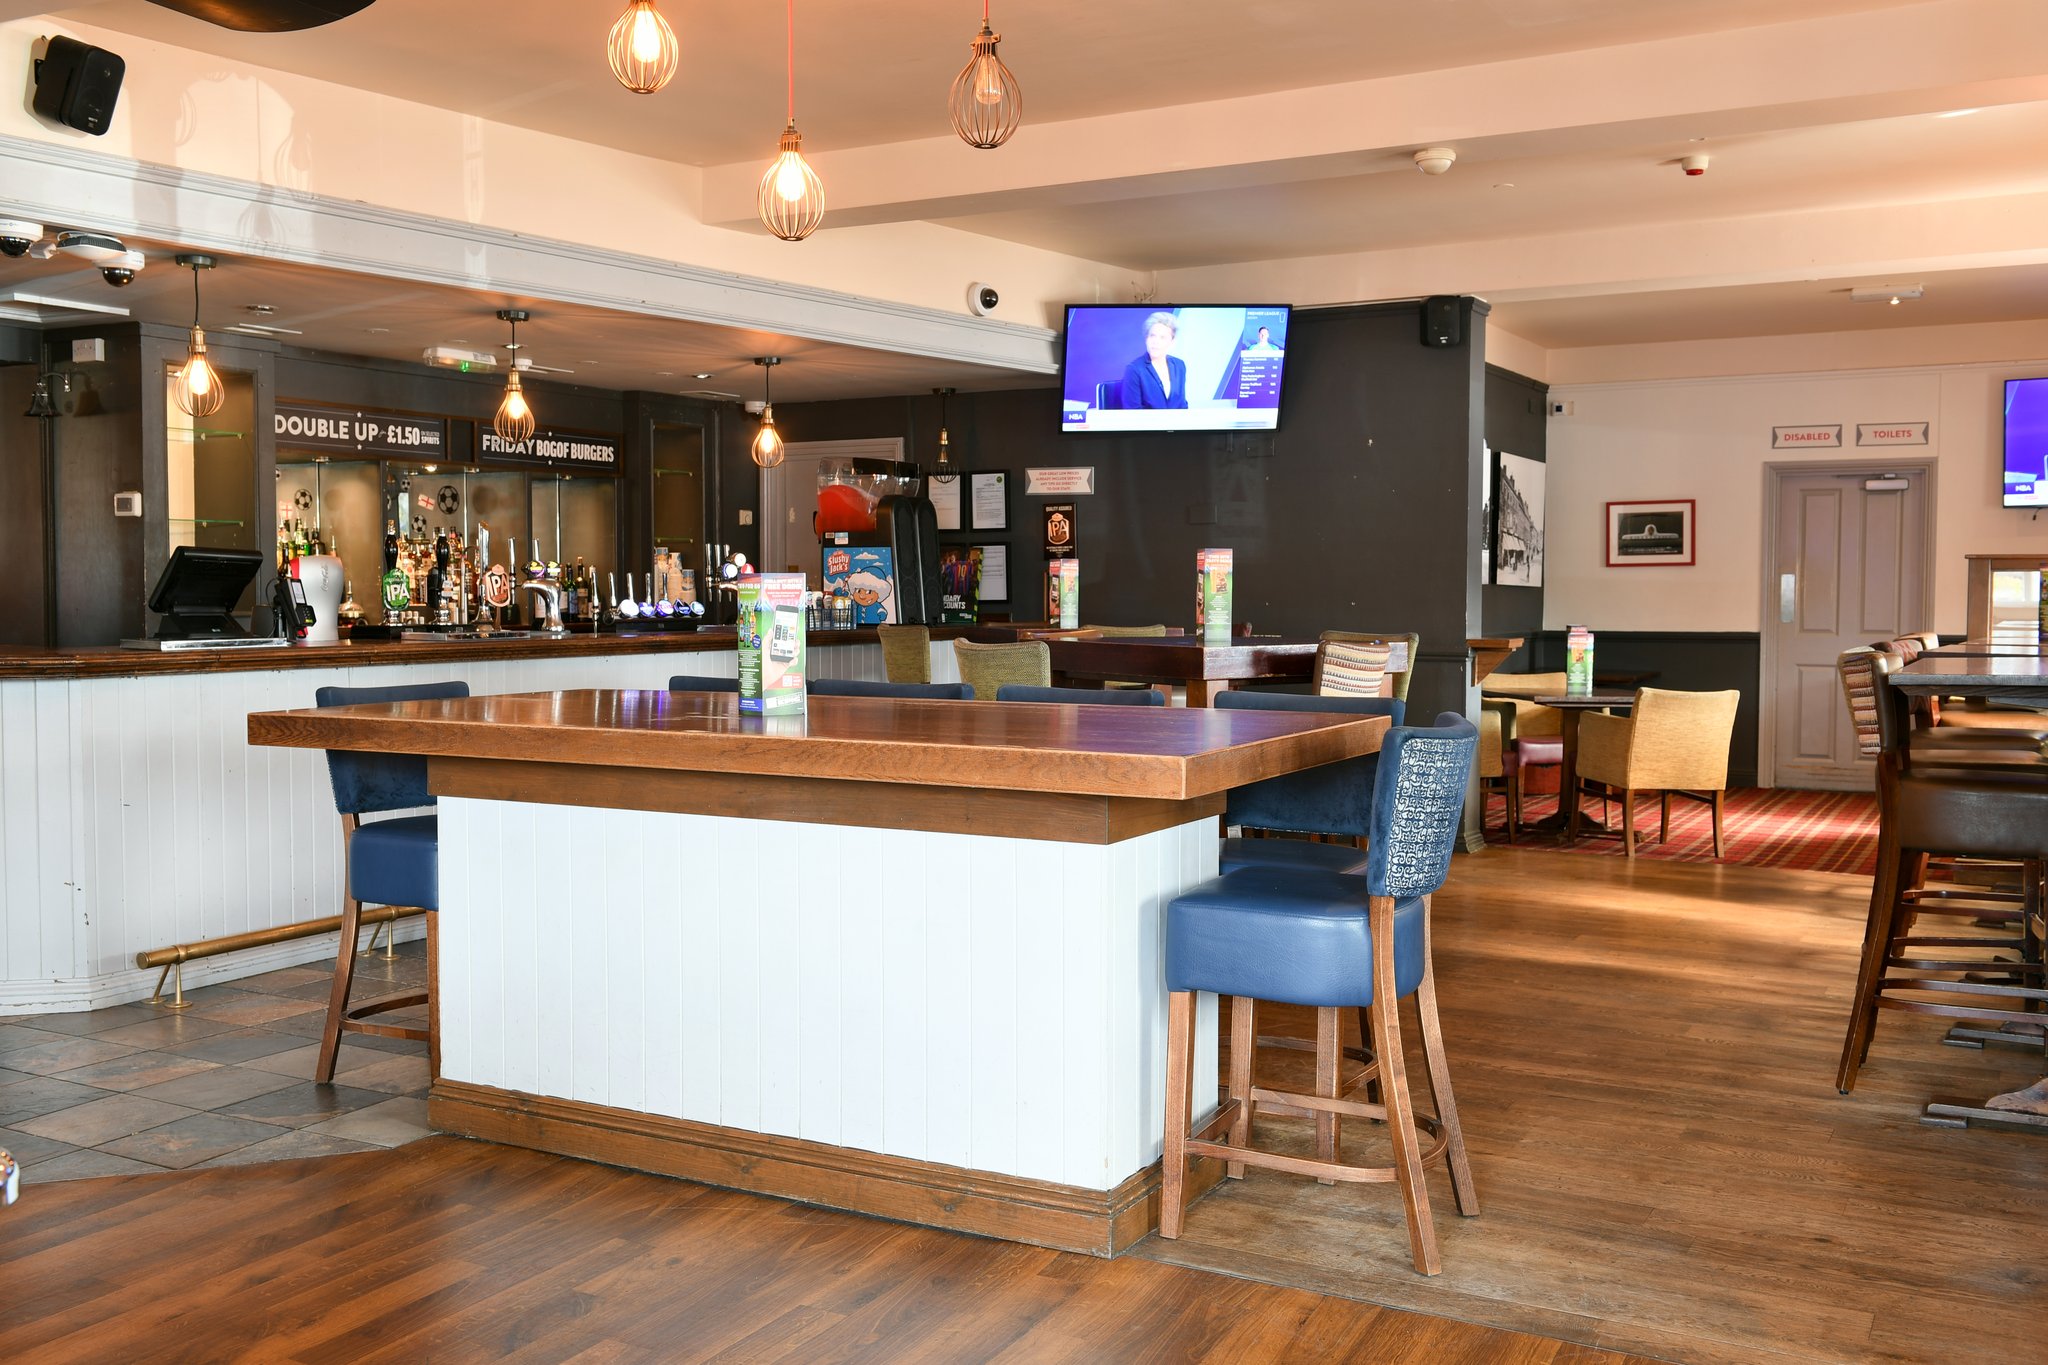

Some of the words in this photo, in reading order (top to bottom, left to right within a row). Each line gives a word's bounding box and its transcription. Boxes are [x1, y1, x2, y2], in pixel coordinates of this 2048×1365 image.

[275, 414, 350, 439] DOUBLE
[355, 422, 379, 441] UP
[387, 425, 420, 446] £1.50
[1784, 433, 1830, 441] DISABLED
[1873, 430, 1912, 439] TOILETS
[421, 436, 440, 445] SPIRITS
[482, 434, 535, 455] FRIDAY
[536, 440, 570, 459] BOGOF
[571, 443, 615, 462] BURGERS
[1048, 520, 1070, 537] IPA
[828, 554, 850, 566] Slushy
[830, 562, 848, 574] Jack's
[386, 583, 410, 602] IPA
[488, 574, 510, 597] IPA
